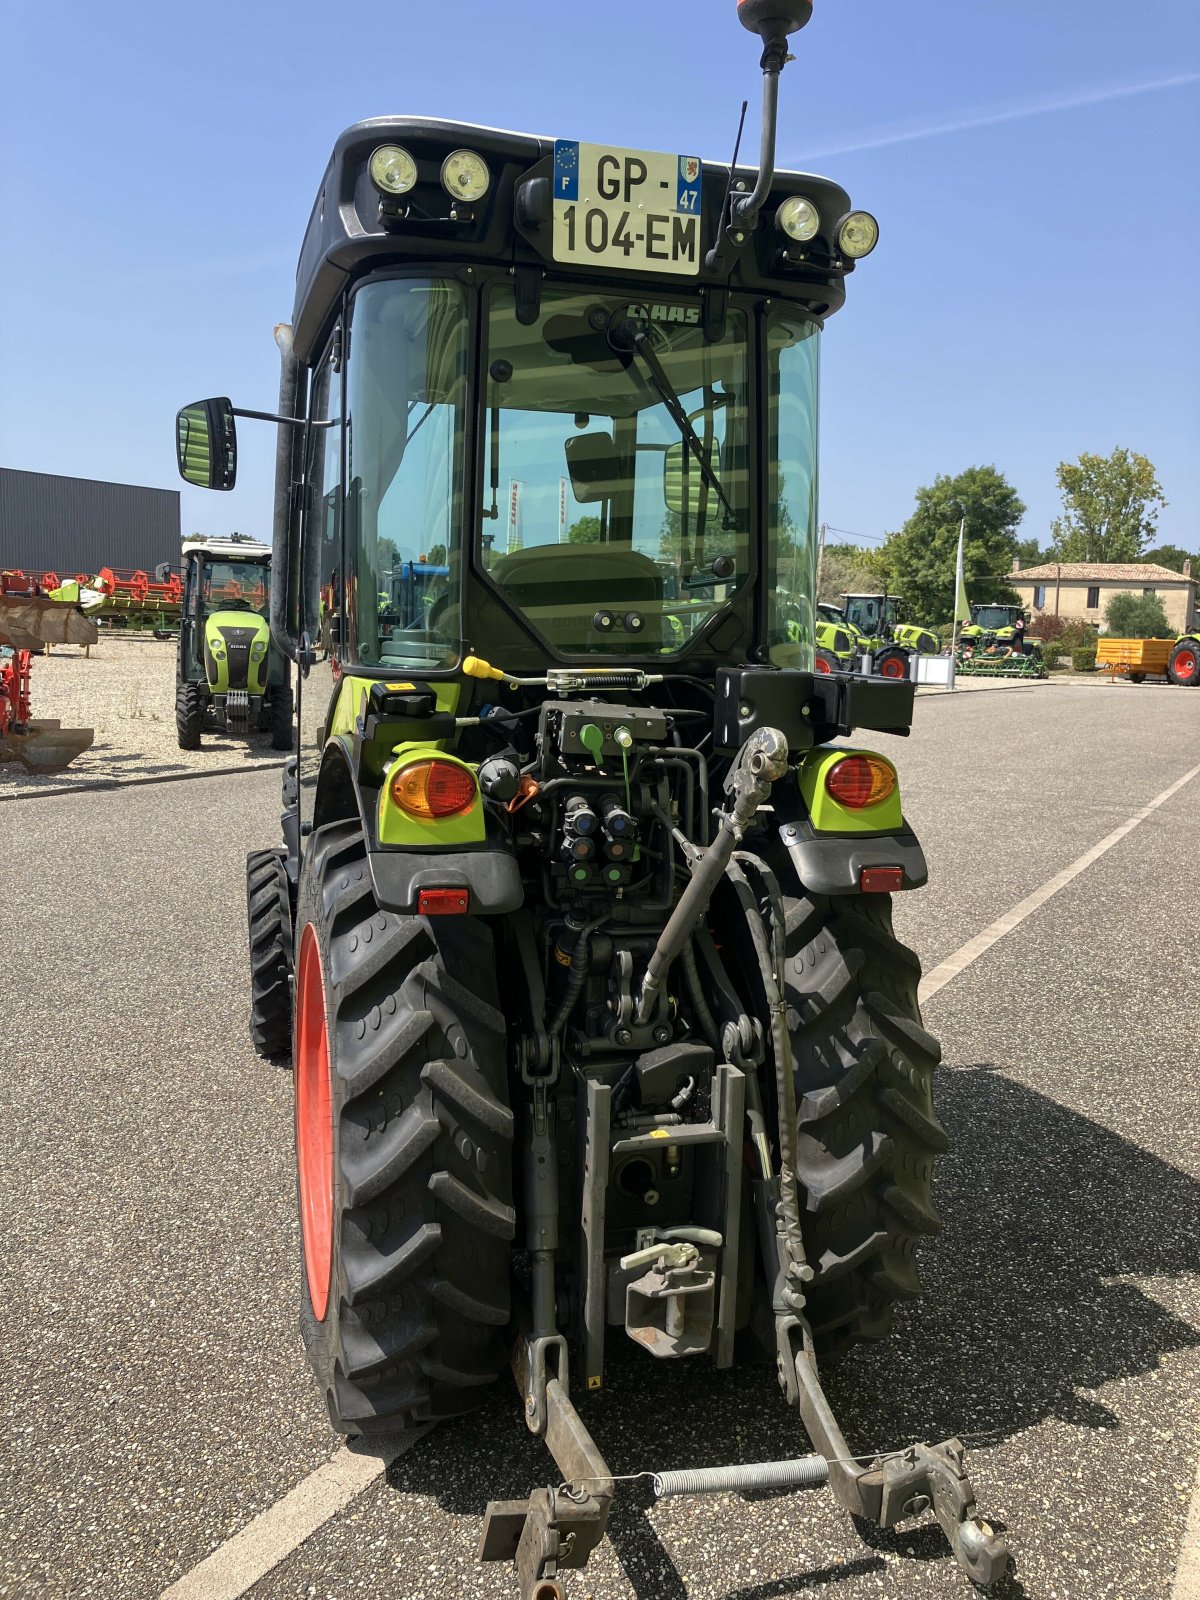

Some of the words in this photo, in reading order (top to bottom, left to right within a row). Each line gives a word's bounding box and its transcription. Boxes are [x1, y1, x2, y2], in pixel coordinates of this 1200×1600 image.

[561, 176, 570, 190] F
[679, 189, 698, 210] 47
[563, 205, 696, 263] 104-EM
[626, 303, 700, 324] CLAAS
